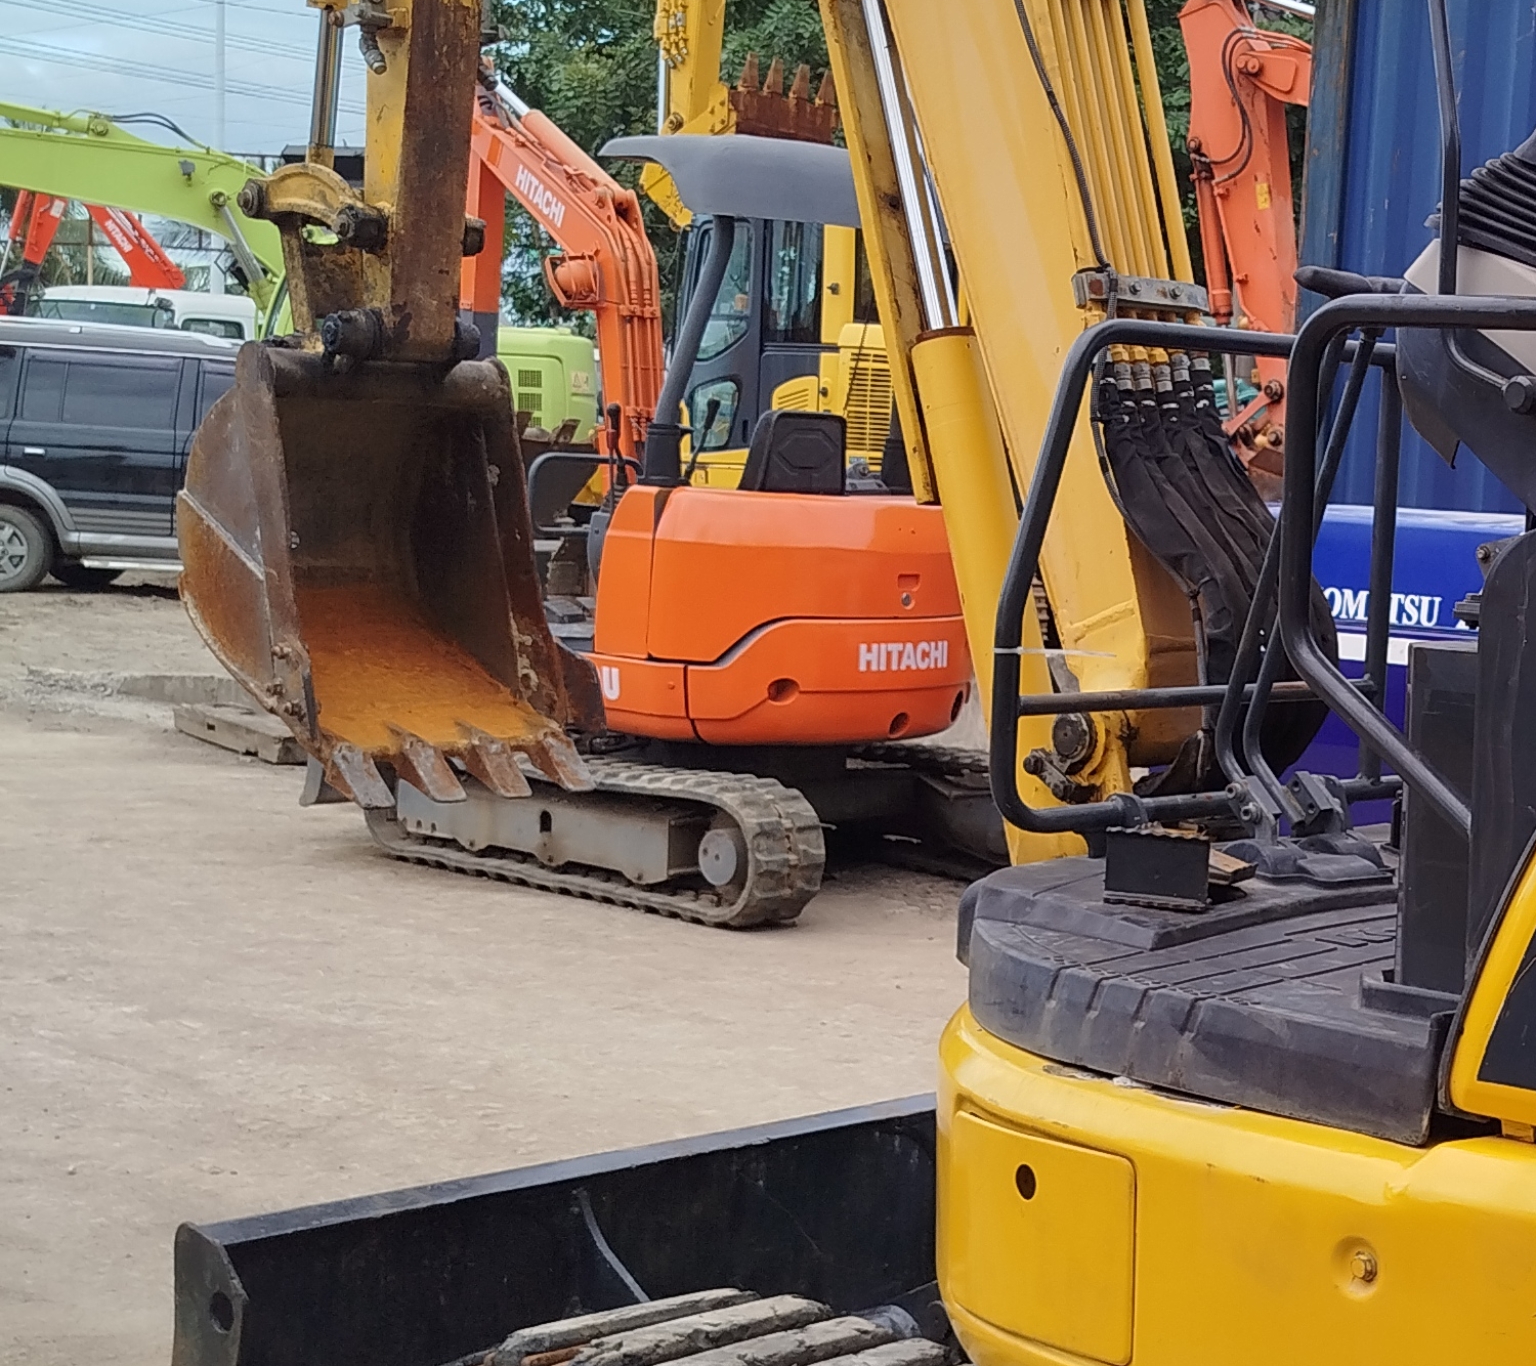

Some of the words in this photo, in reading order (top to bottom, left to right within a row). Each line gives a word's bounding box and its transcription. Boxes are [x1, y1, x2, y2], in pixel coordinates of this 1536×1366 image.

[515, 164, 566, 228] HITACHI
[1321, 586, 1442, 627] OMTSU
[858, 640, 949, 673] HITACHI
